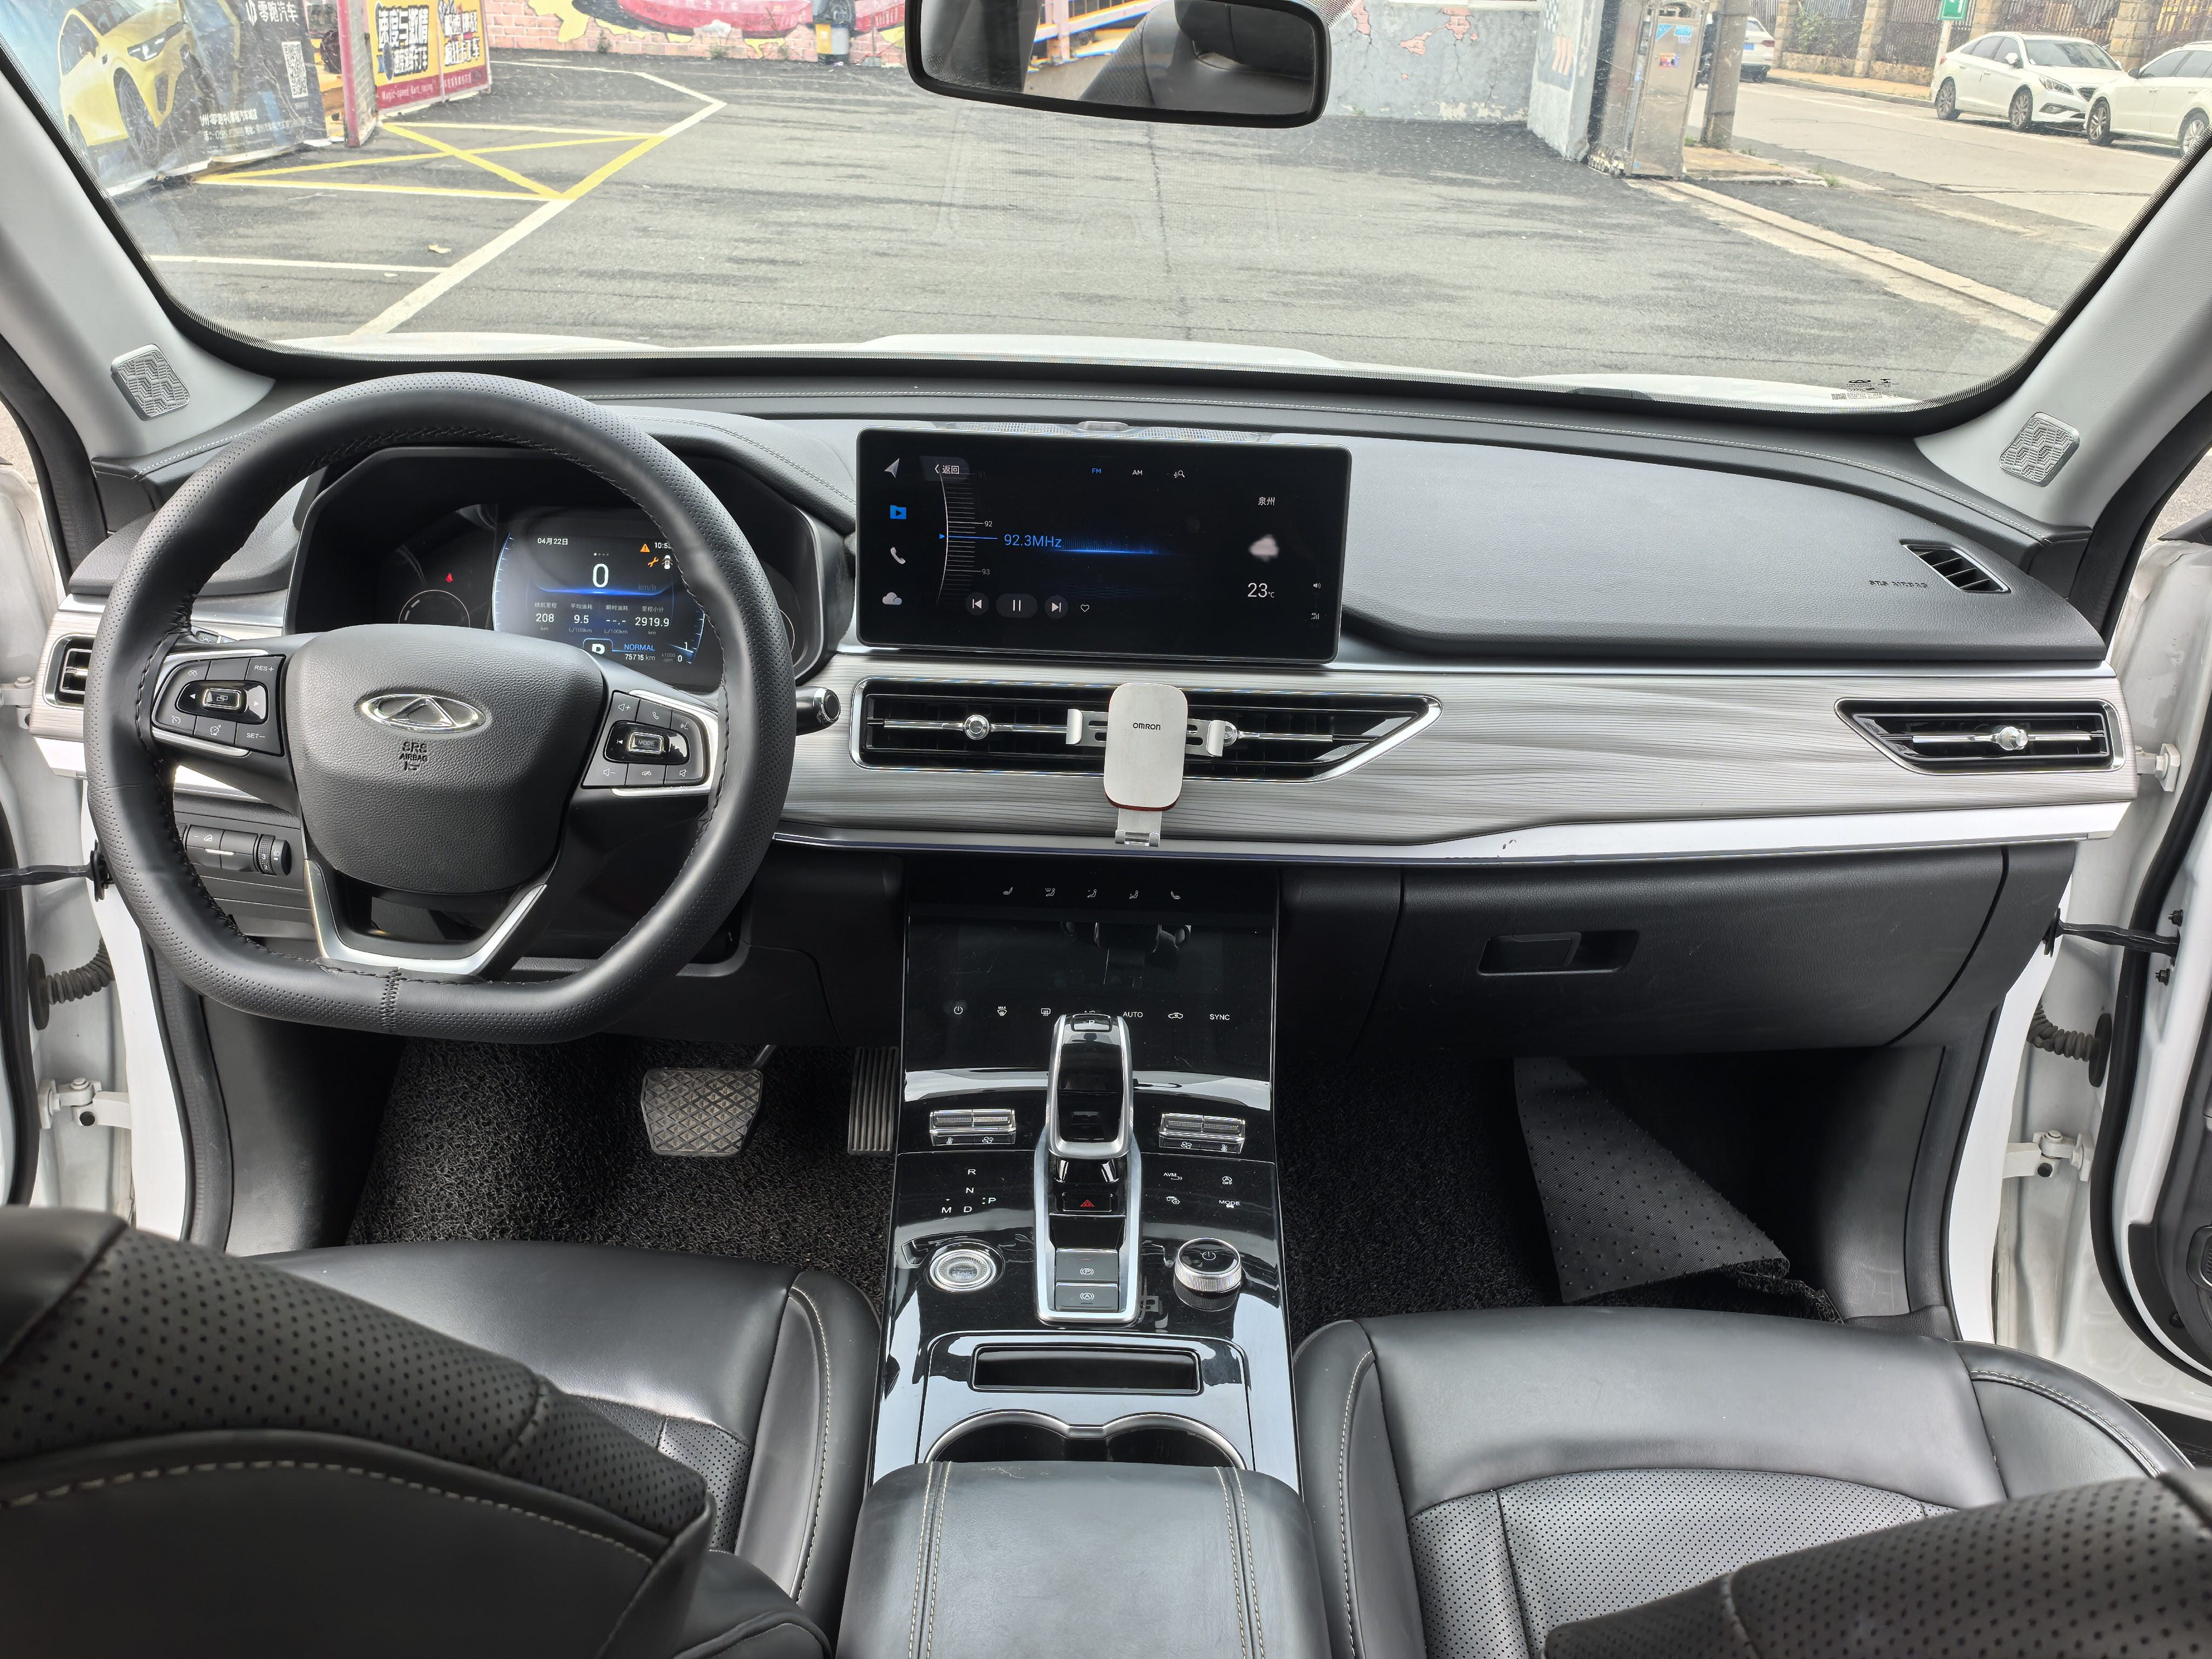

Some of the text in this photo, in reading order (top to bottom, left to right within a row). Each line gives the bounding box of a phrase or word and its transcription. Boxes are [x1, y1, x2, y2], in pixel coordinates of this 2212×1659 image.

[258, 1, 299, 22] 零跑汽车
[942, 465, 960, 474] 返回
[1258, 496, 1276, 505] 泉州
[1003, 534, 1062, 548] 92.3MHz
[592, 563, 609, 588] 0
[638, 583, 657, 591] km/h
[536, 613, 554, 622] 208
[574, 615, 589, 624] 9.5
[635, 617, 670, 627] 2919.9
[624, 643, 655, 651] NORMAL
[402, 741, 427, 753] SRS
[399, 753, 428, 762] AIRBAG
